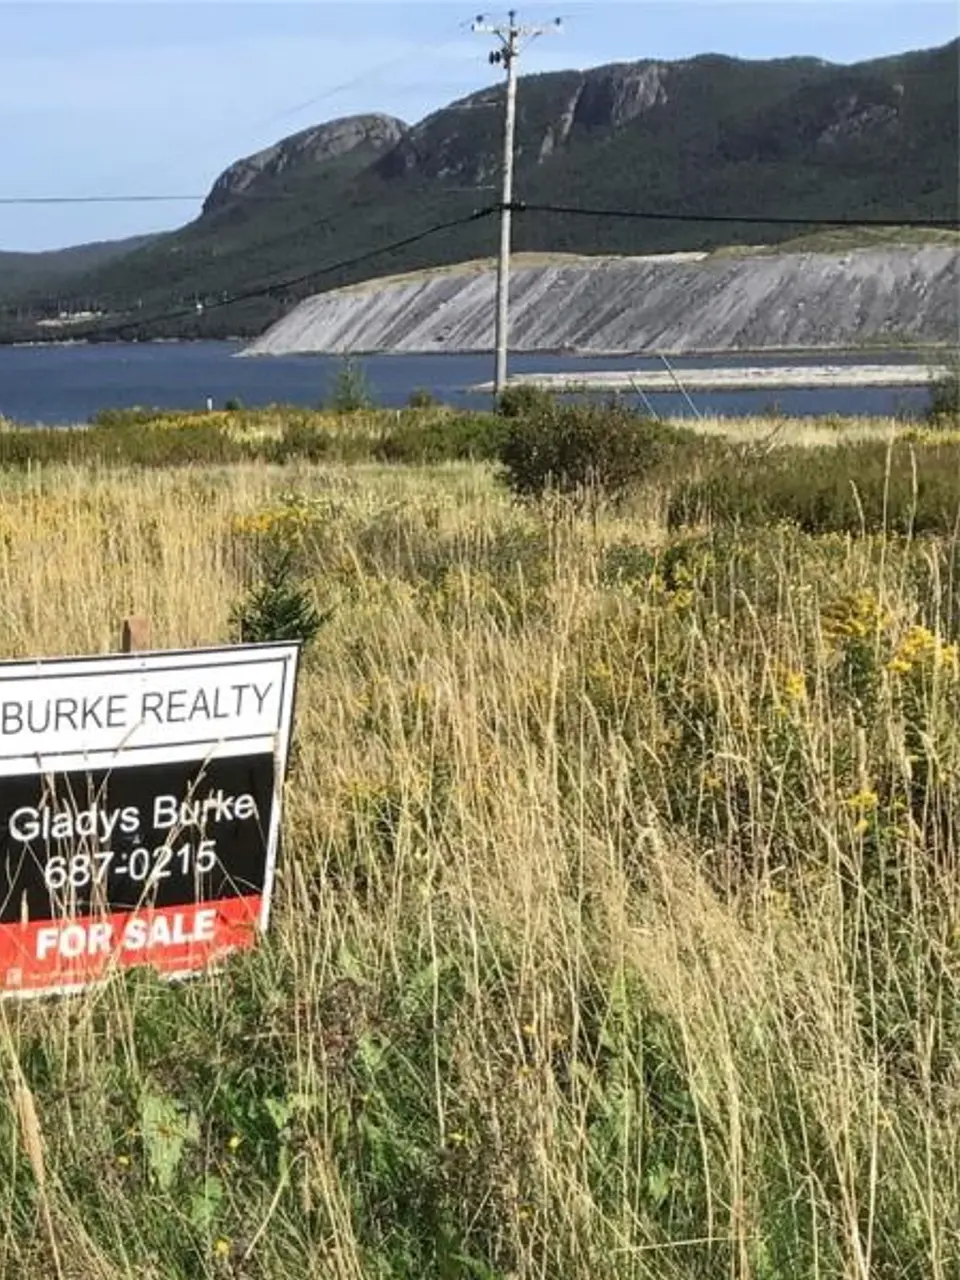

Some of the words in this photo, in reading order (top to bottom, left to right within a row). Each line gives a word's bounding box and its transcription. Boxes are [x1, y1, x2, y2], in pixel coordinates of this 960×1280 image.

[0, 694, 128, 736] BURKE
[140, 682, 274, 724] REALTY
[8, 801, 141, 844] Gladys
[153, 789, 256, 831] Burke
[44, 840, 217, 890] 687-0215
[36, 922, 113, 961] FOR
[124, 908, 217, 950] SALE
